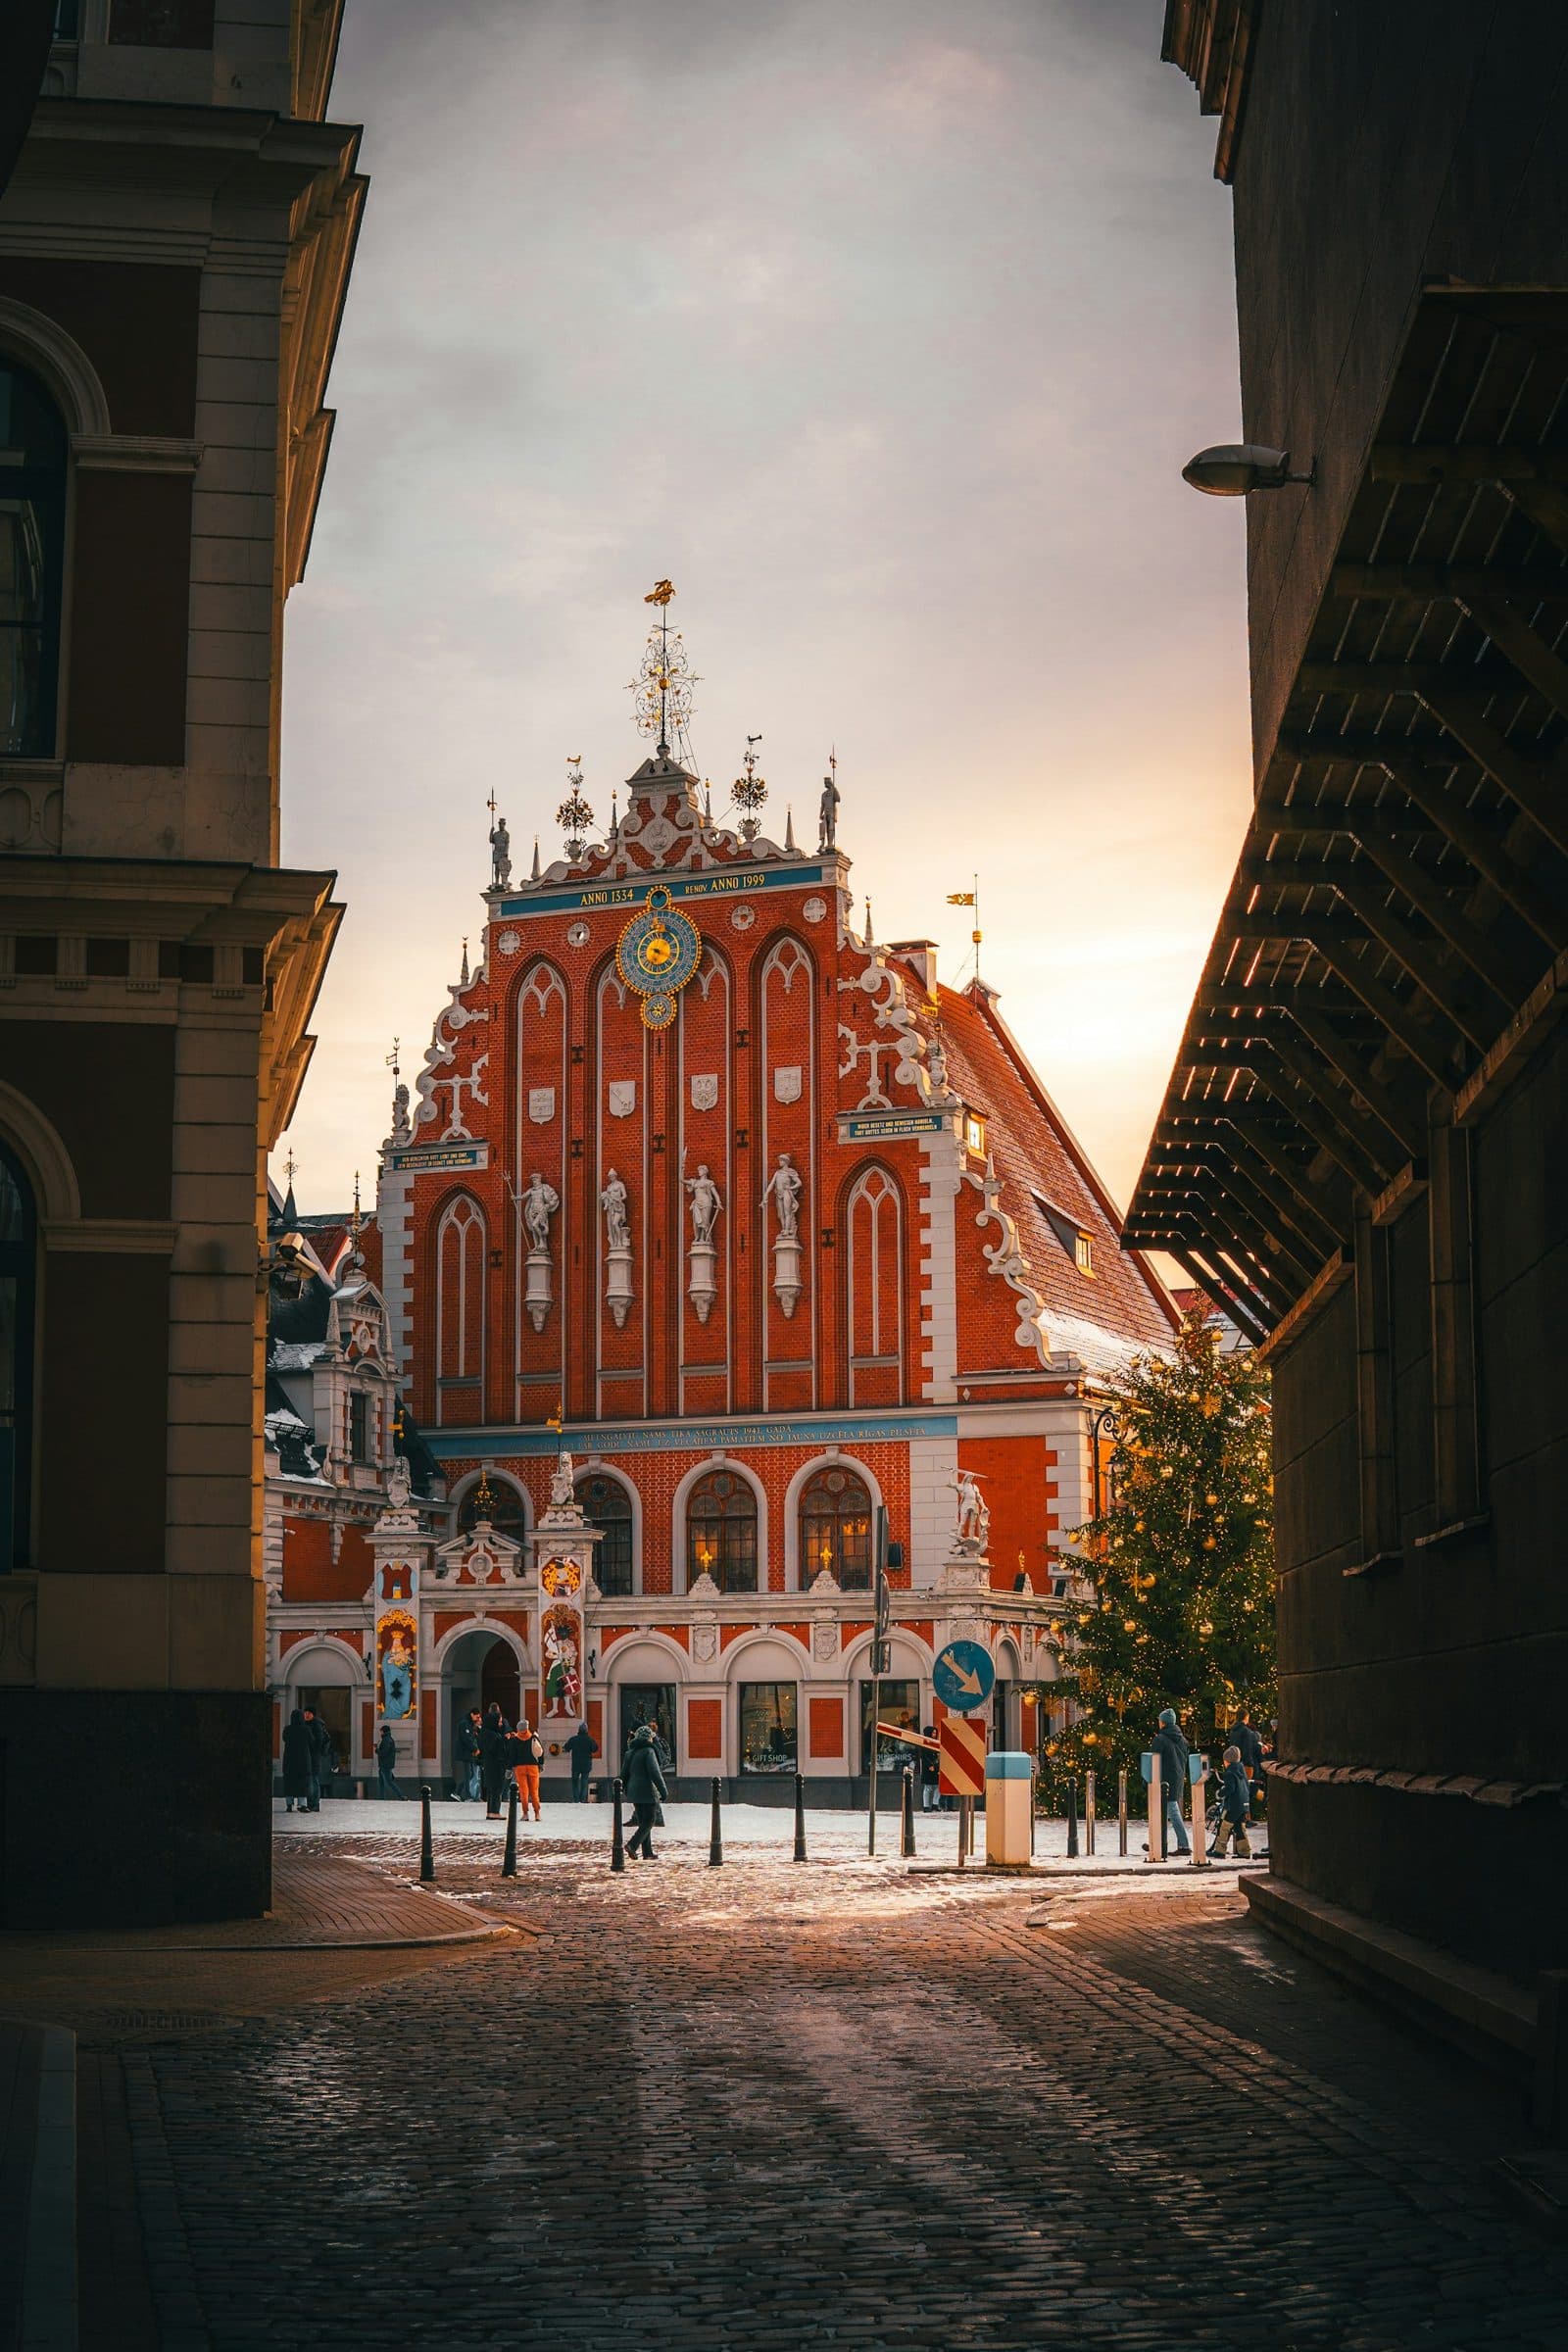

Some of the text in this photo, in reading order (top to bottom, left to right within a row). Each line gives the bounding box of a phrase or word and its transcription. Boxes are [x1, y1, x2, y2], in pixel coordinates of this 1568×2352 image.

[710, 876, 739, 891] ANNO
[743, 874, 765, 887] 1999
[580, 889, 634, 906] ANNO 1334
[768, 1434, 784, 1443] NO
